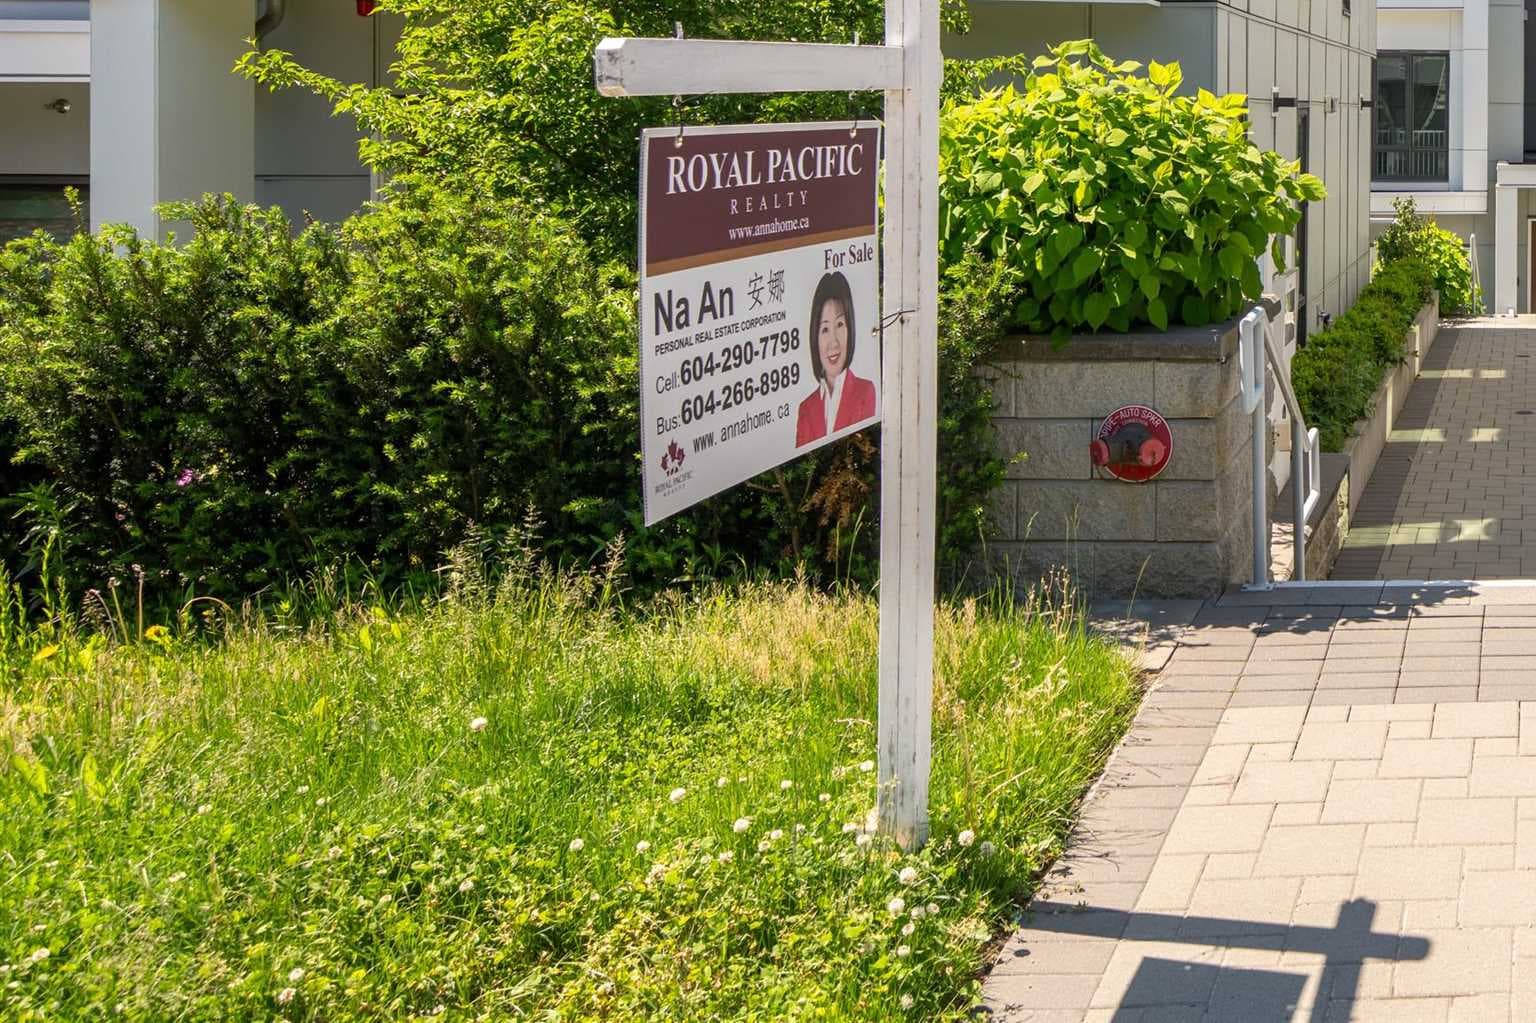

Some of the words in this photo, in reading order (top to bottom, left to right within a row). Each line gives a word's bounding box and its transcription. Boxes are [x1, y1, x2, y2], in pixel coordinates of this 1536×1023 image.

[665, 150, 761, 195] ROYAL
[766, 143, 864, 183] PACIFIC
[730, 190, 808, 215] REALTY
[728, 216, 810, 240] www.annahome.ca
[824, 248, 845, 270] For
[848, 242, 873, 266] Sale
[654, 288, 690, 336] Na
[697, 280, 734, 324] An
[747, 269, 785, 311] 安娜
[655, 337, 694, 356] PERSONAL
[695, 328, 714, 343] REAL
[715, 322, 740, 339] ESTATE
[741, 311, 787, 332] CORPORATION
[680, 327, 800, 385] 604-290-7798
[681, 362, 800, 425] 604-266-8989
